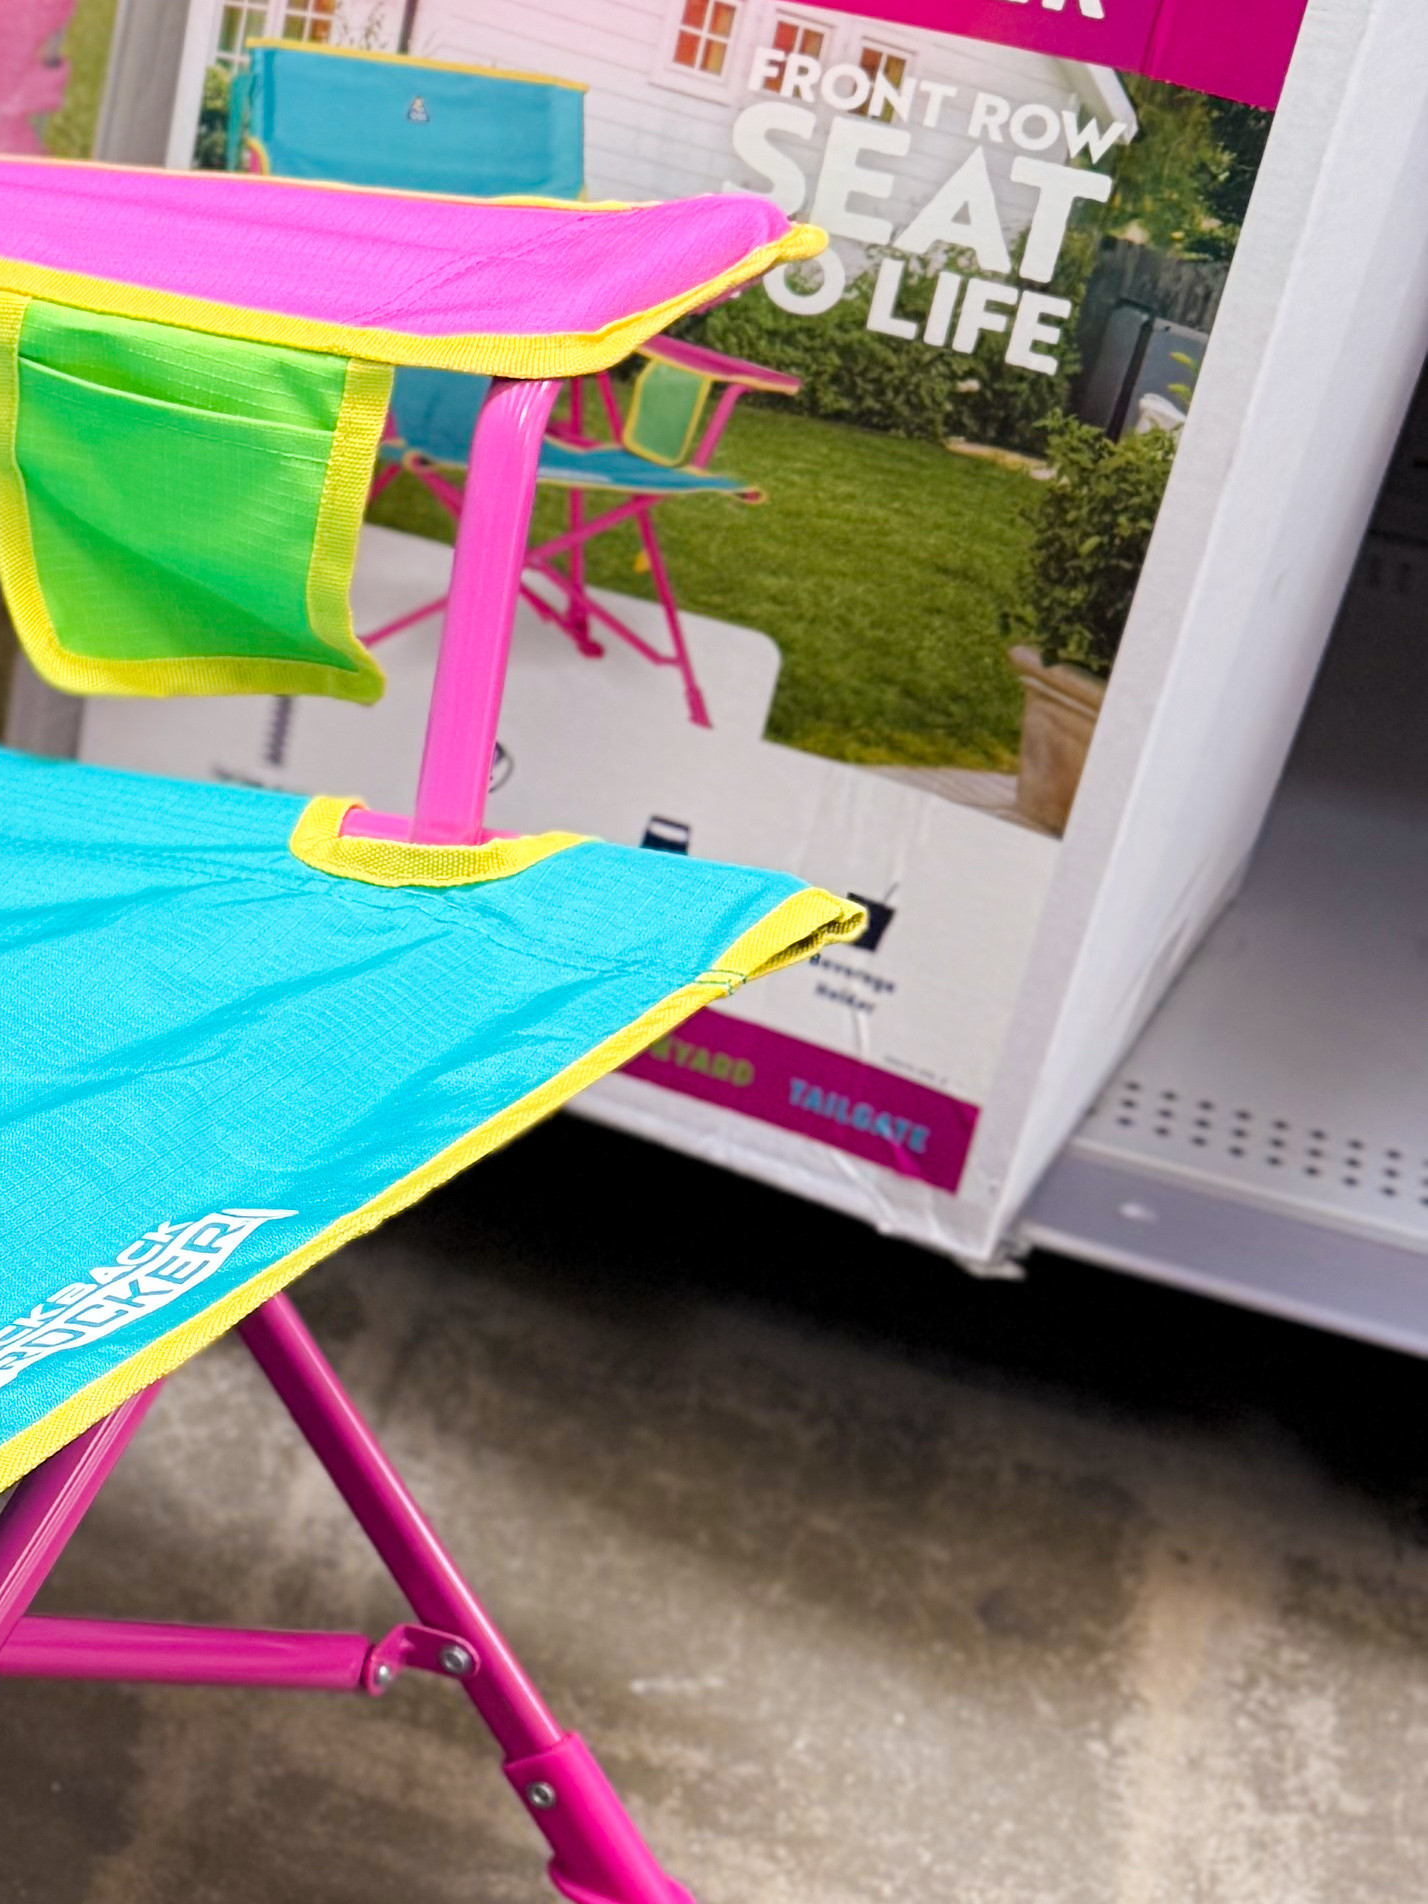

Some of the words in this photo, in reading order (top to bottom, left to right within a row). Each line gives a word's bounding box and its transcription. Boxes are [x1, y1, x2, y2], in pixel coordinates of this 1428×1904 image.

[748, 46, 957, 123] FRONT
[966, 91, 1127, 164] ROW
[721, 101, 1113, 284] SEAT
[866, 257, 1072, 376] LIFE
[789, 1076, 931, 1154] TAILGATE
